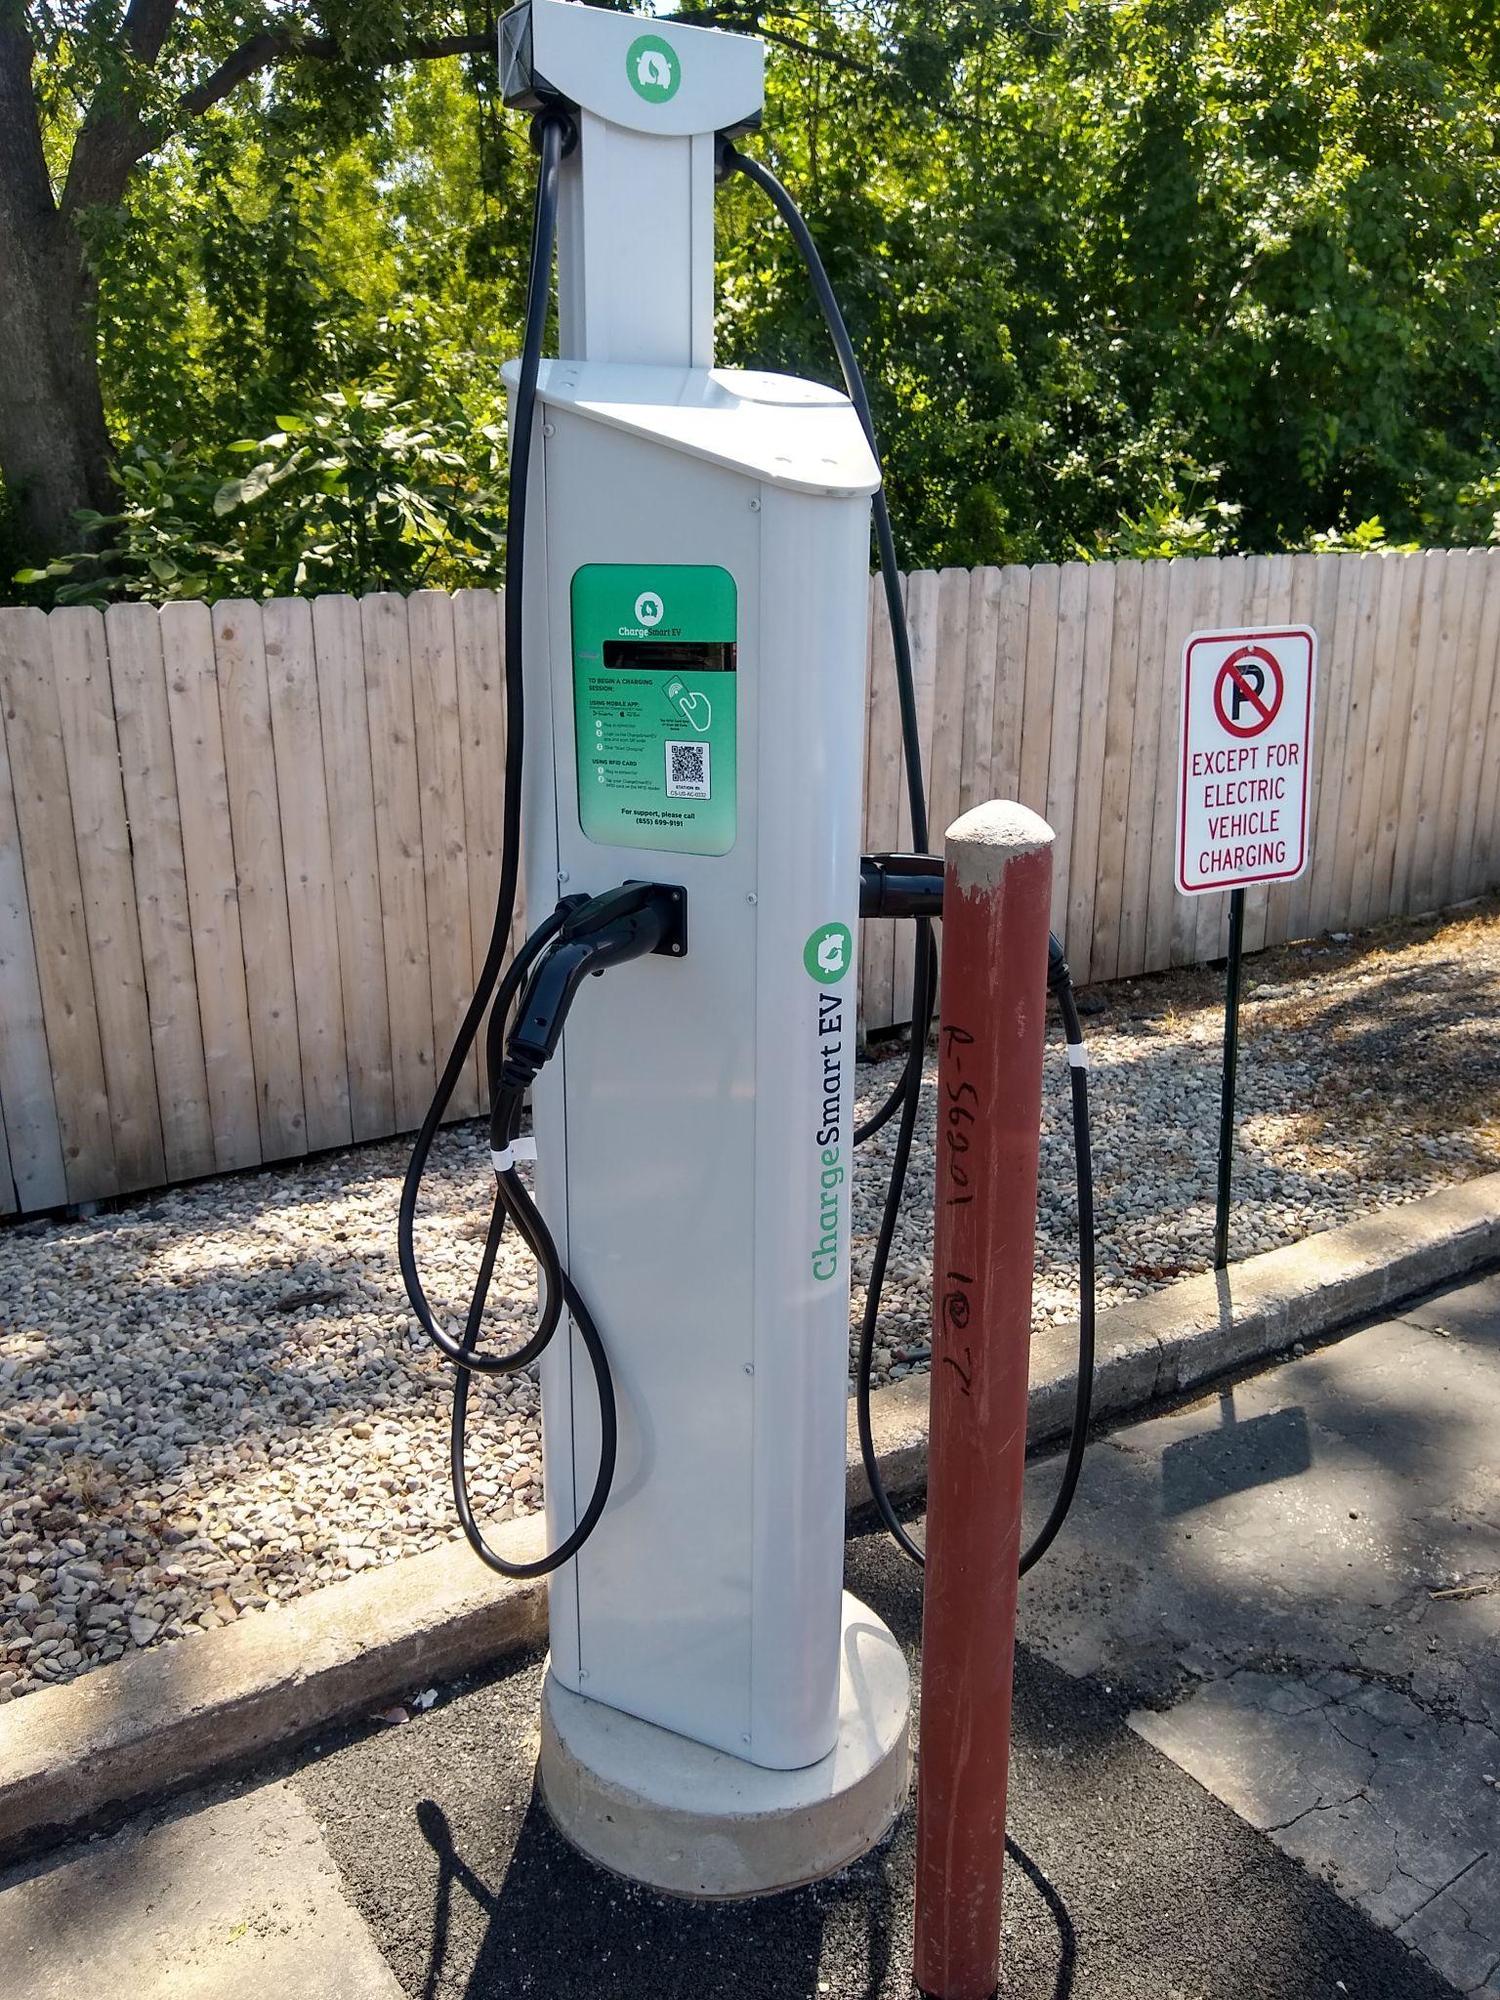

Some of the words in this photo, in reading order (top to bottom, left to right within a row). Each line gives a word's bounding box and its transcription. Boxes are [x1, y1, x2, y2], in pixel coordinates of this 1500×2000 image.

[618, 627, 671, 638] ChargeSmart
[671, 628, 682, 636] EV
[1192, 747, 1259, 776] EXCEPT
[1266, 743, 1299, 768] FOR
[1204, 777, 1285, 809] ELECTRIC
[633, 809, 660, 818] support,
[661, 811, 682, 819] please
[1208, 810, 1280, 840] VEHICLE
[1199, 841, 1285, 874] CHARGING
[819, 993, 842, 1036] EV
[812, 1042, 844, 1281] ChargeSmart
